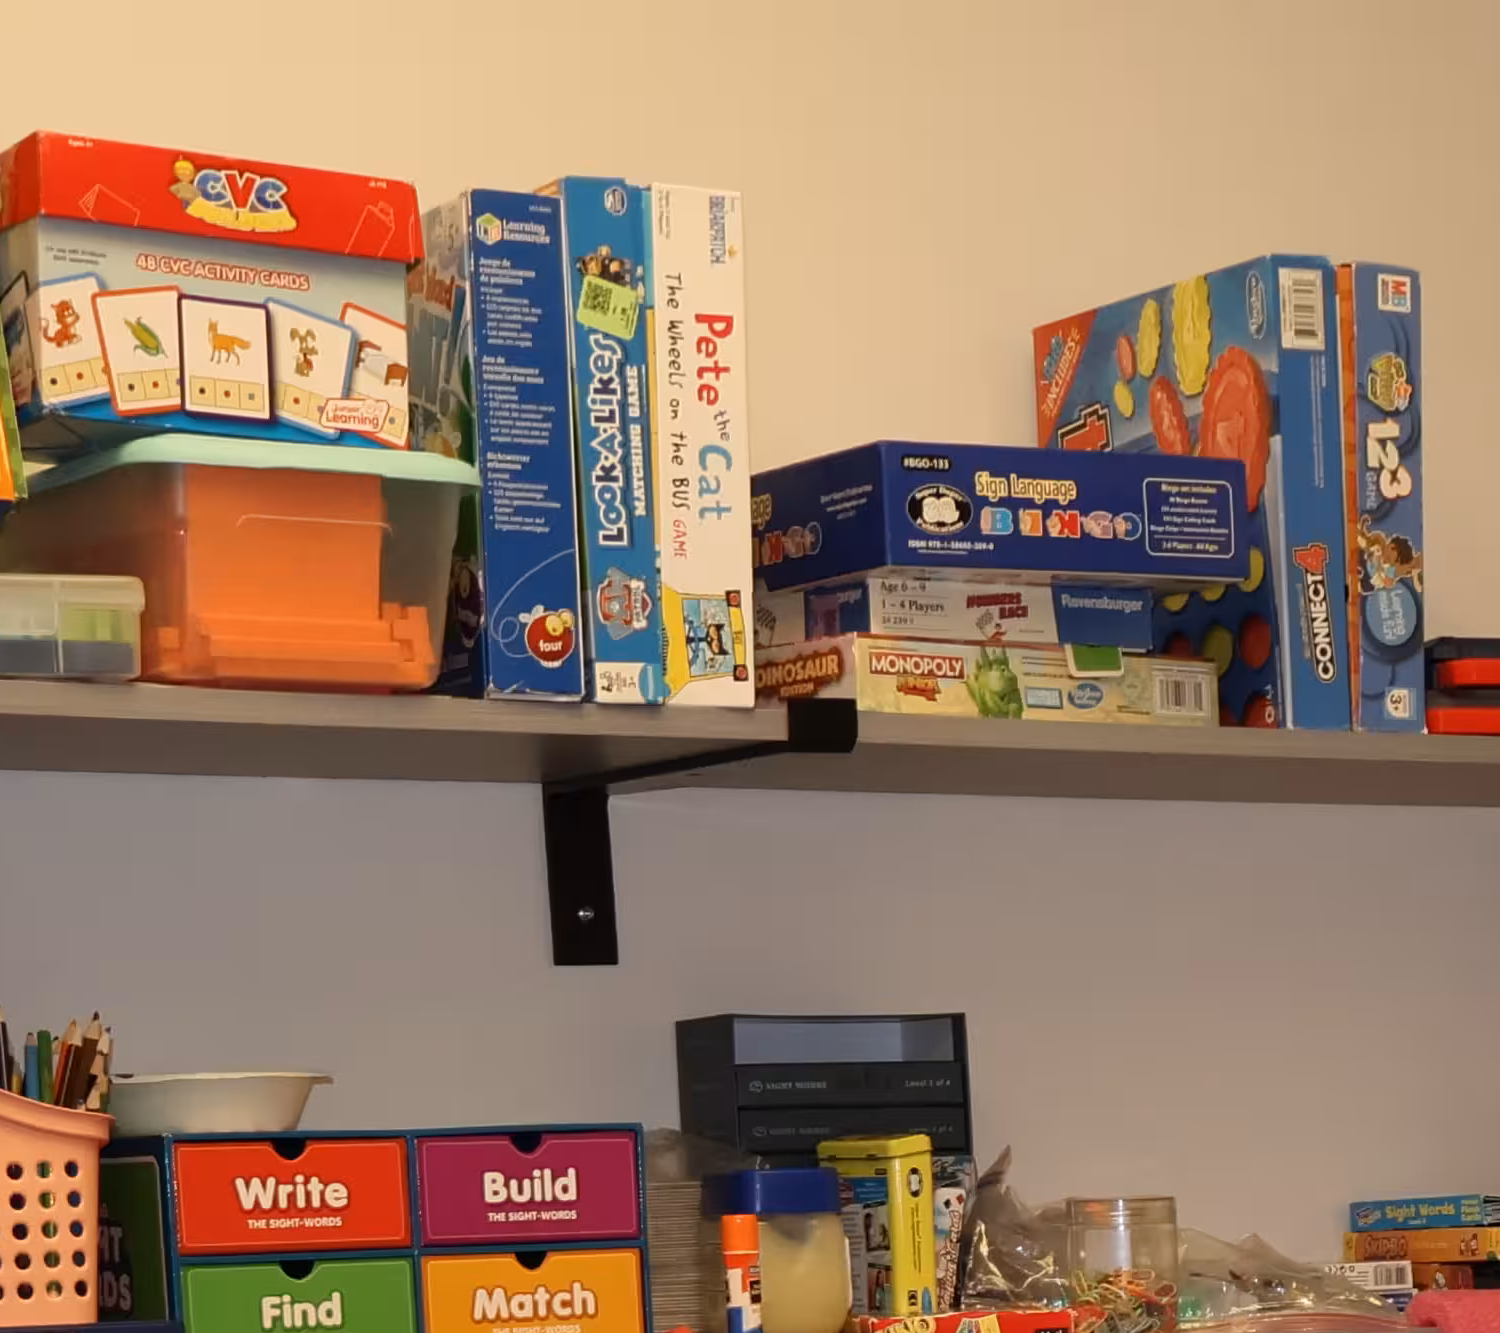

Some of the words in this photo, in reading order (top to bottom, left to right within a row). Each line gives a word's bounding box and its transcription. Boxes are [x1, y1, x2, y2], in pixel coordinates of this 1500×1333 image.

[193, 167, 289, 213] CVC
[503, 218, 546, 235] Learning
[136, 255, 159, 271] 48
[160, 258, 191, 276] CVC
[193, 261, 258, 285] ACTIVITY
[258, 269, 310, 291] CARDS
[665, 272, 683, 310] The
[667, 319, 687, 389] Wheels
[694, 312, 734, 406] Pete
[626, 365, 641, 417] GAME
[324, 409, 380, 428] Learning
[670, 398, 681, 420] on
[713, 409, 731, 441] the
[669, 431, 688, 467] the
[628, 424, 647, 517] MATCHING
[697, 443, 733, 521] Cat
[975, 471, 1009, 502] Sign
[1010, 473, 1077, 505] Language
[671, 477, 690, 512] BUS
[672, 519, 688, 560] GAME
[1292, 542, 1329, 574] 4
[880, 581, 898, 594] Age
[901, 581, 908, 592] 6
[1060, 593, 1144, 614] Ravensburger
[908, 600, 945, 613] Players
[1306, 570, 1336, 683] CONNECT
[538, 638, 563, 653] four
[755, 655, 840, 689] DINOSAUR
[870, 654, 964, 678] MONOPOLY
[234, 1174, 350, 1211] Write
[483, 1167, 578, 1206] Build
[247, 1218, 267, 1229] THE
[268, 1215, 343, 1229] SIGHT-WORDS
[488, 1211, 507, 1222] THE
[508, 1209, 578, 1222] SIGHT-WORDS
[1384, 1204, 1416, 1221] Sight
[1418, 1203, 1456, 1217] Words
[260, 1291, 343, 1330] Find
[472, 1282, 596, 1323] Match
